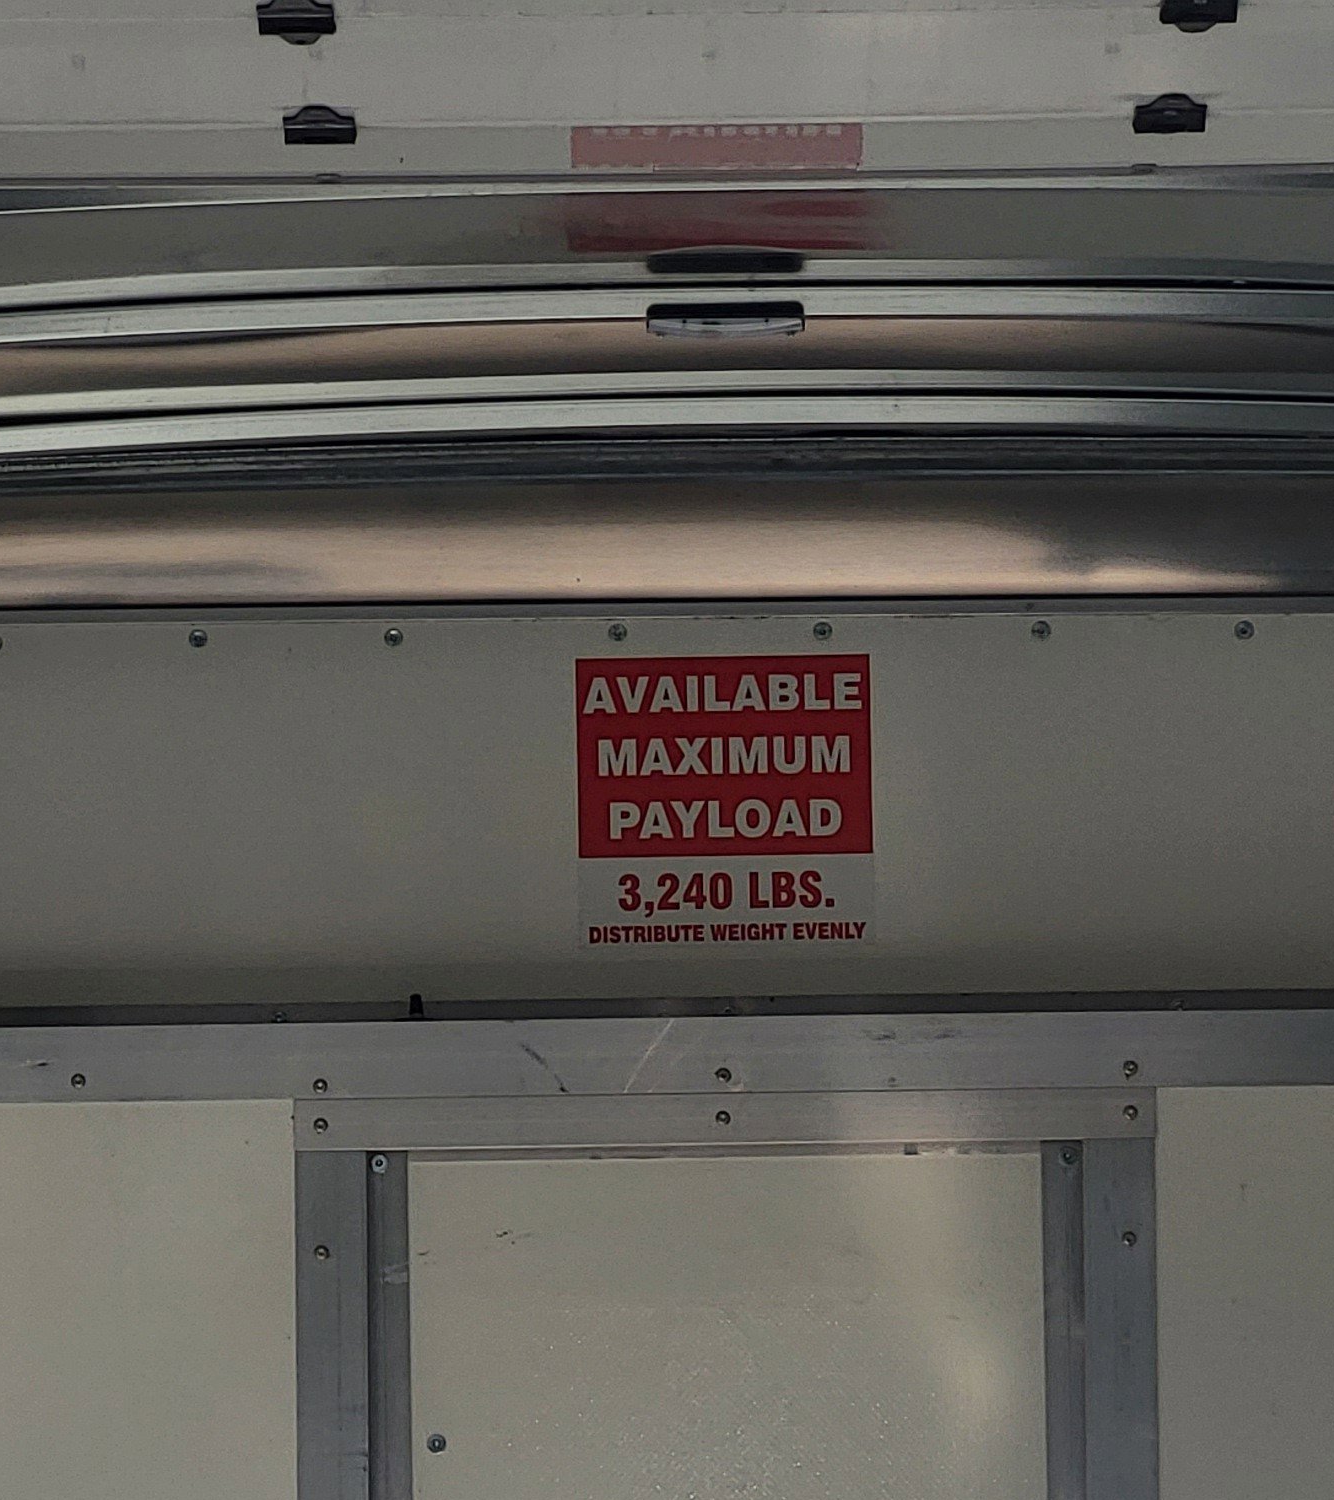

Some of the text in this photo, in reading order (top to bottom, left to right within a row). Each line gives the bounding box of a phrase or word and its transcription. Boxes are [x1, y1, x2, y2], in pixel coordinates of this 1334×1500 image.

[582, 673, 863, 714] AVAILABLE
[597, 735, 851, 776] MAXIMUM
[608, 798, 843, 840] PAYLOAD
[618, 870, 836, 918] 3,240 LBS.
[588, 922, 866, 944] DISTRIBUTE WEIGHT EVENLY
